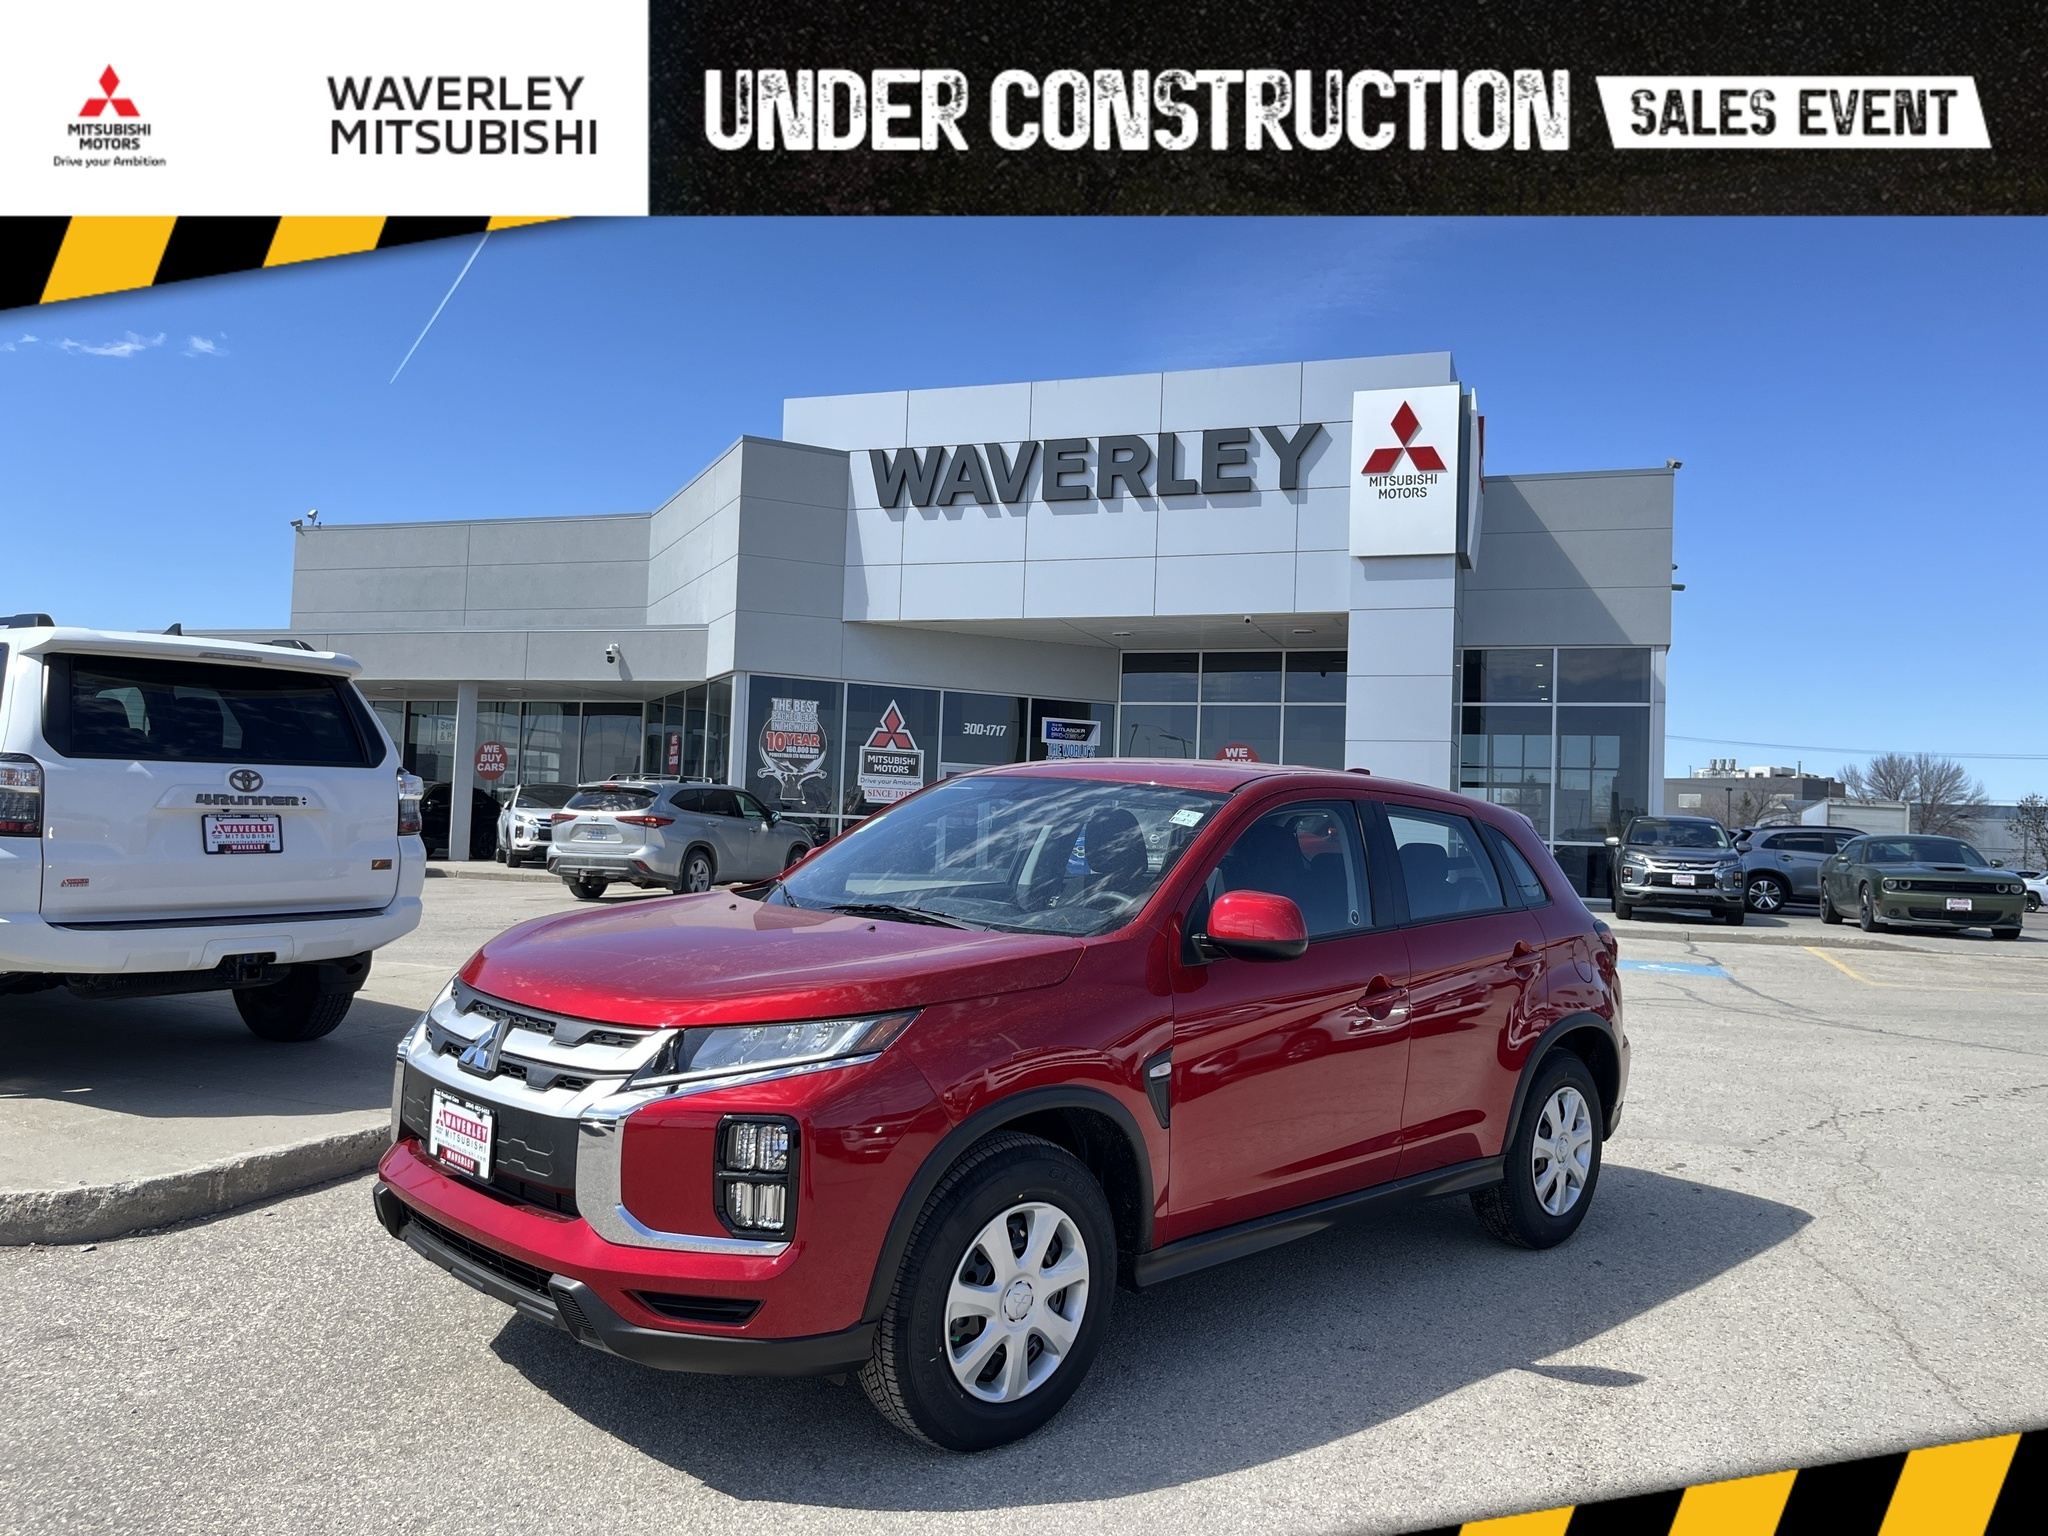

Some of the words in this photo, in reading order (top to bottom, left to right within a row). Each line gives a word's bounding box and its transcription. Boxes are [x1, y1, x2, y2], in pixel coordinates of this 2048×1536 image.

[868, 422, 1323, 508] WAVERLEY
[1369, 473, 1438, 488] MITSUBISHI
[1378, 487, 1428, 500] MOTORS
[771, 697, 792, 711] THE
[793, 698, 820, 713] BEST
[963, 722, 1007, 737] 300-1717
[1051, 726, 1086, 734] OUTLANDER
[766, 731, 787, 752] 10
[785, 732, 821, 747] YEAR
[483, 744, 500, 753] WE
[1047, 743, 1062, 757] THE
[1062, 744, 1096, 759] WORLD'S
[1225, 747, 1248, 758] WE
[480, 754, 503, 762] BUY
[867, 755, 916, 766] MITSUBISHI
[477, 763, 505, 772] CARS
[874, 764, 910, 774] MOTORS
[892, 779, 922, 787] Ambition
[867, 789, 893, 798] SINCE
[223, 825, 274, 833] WAVERLEY
[444, 1111, 488, 1143] WAVERLEY
[445, 1129, 487, 1154] MITSUBISHI
[446, 1148, 475, 1171] WAVERLEY
